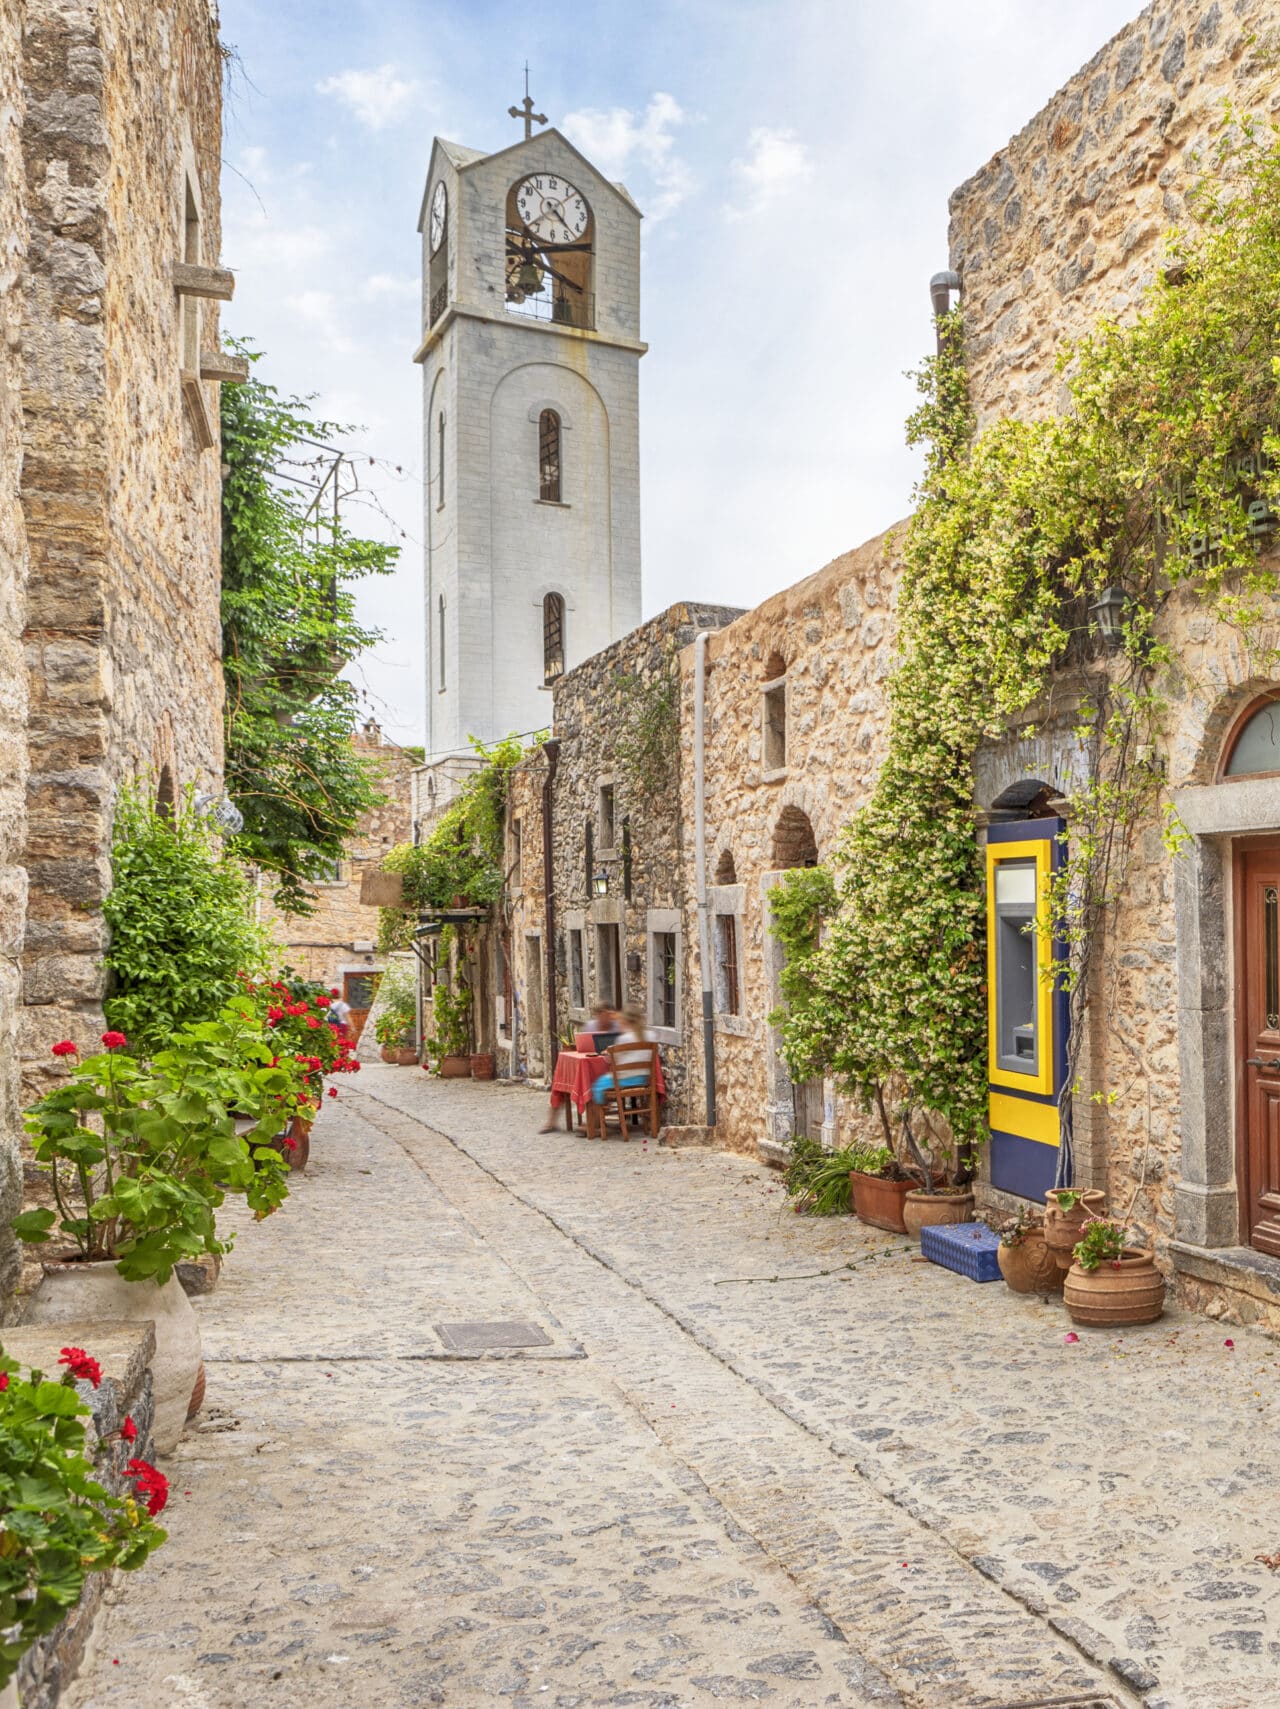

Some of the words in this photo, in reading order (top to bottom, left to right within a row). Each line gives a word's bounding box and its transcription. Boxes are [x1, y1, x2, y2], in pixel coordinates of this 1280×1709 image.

[536, 180, 542, 190] 11
[549, 179, 557, 190] 12
[525, 186, 533, 196] 10
[520, 198, 526, 208] 9
[575, 199, 580, 209] 2
[525, 210, 531, 221] 8
[579, 211, 585, 222] 3
[574, 222, 580, 232] 4
[563, 230, 569, 240] 5
